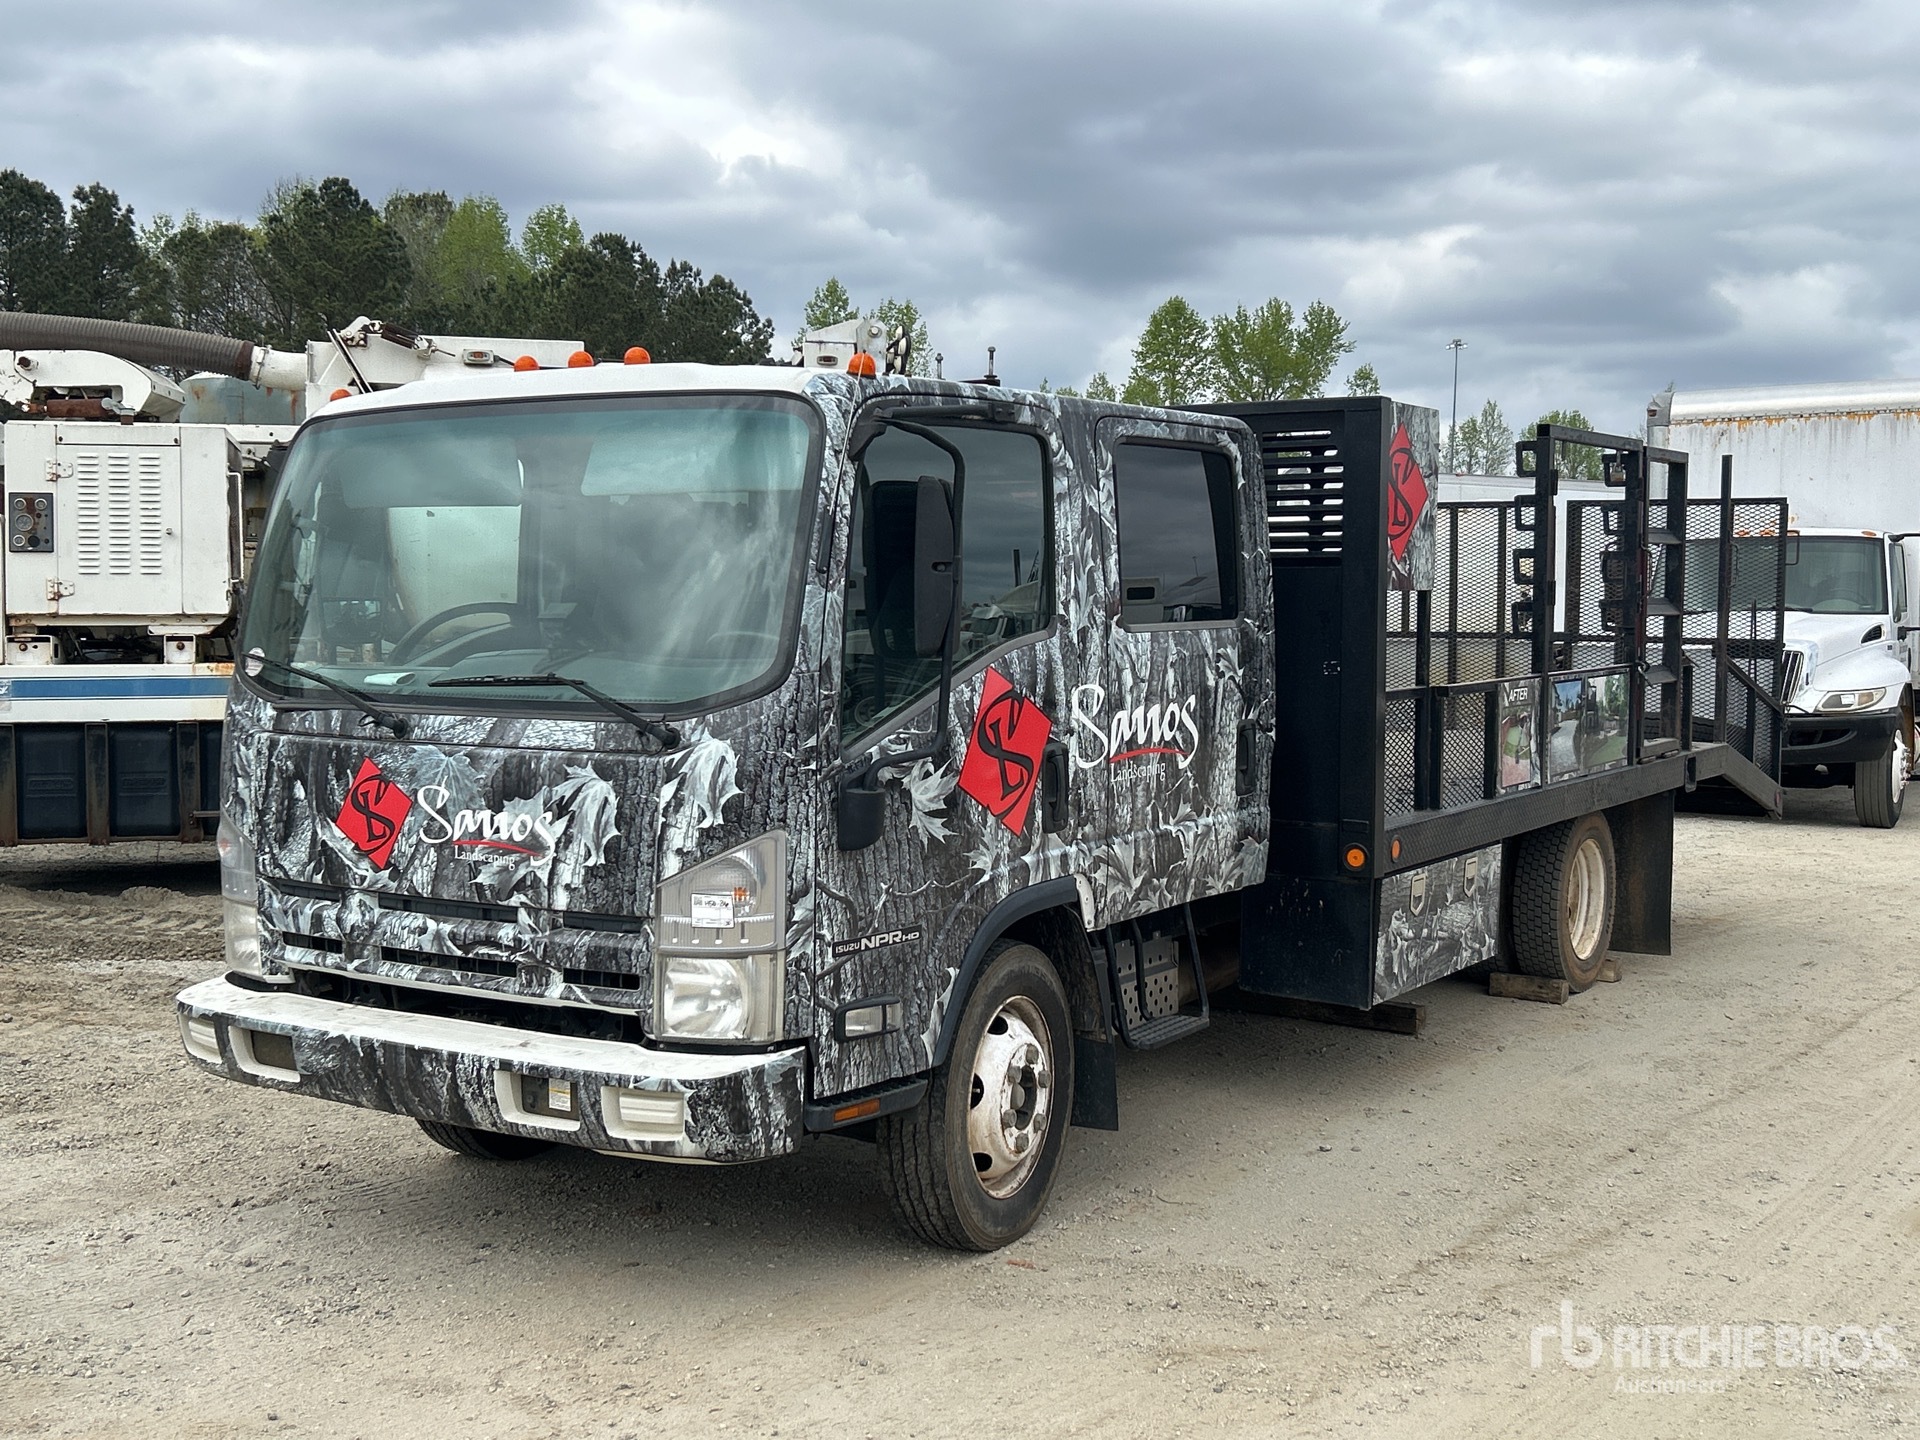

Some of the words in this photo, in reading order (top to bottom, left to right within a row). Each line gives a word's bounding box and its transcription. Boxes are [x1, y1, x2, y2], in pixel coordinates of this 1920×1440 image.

[1508, 687, 1528, 702] AFTER
[1110, 761, 1166, 782] Landscaping
[454, 845, 515, 871] Landscaping
[835, 941, 860, 954] ISUZU
[860, 930, 902, 951] NPR
[902, 931, 920, 942] HD
